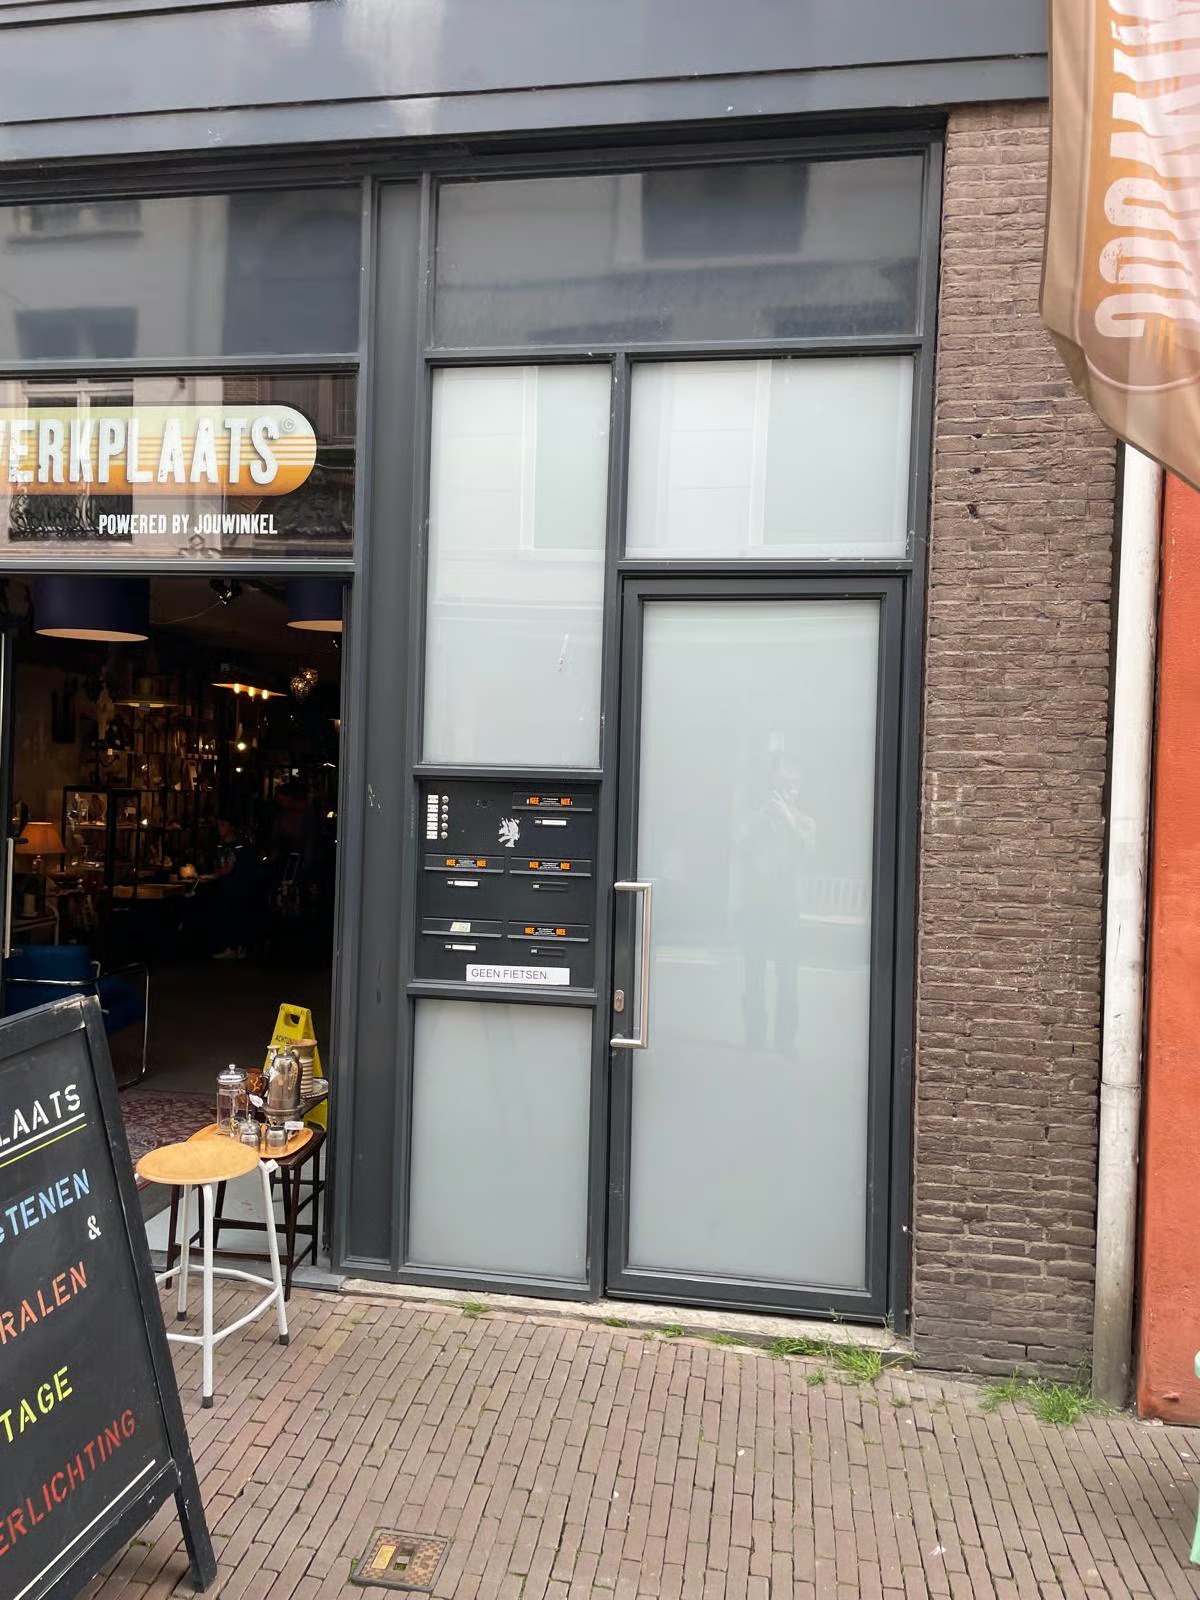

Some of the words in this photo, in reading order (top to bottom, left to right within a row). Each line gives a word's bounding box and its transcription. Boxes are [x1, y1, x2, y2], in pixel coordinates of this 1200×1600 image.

[0, 418, 280, 485] ERKPLAATS
[98, 514, 167, 534] POWERED
[171, 514, 190, 534] BY
[193, 514, 278, 535] JOUWINKEL
[471, 968, 501, 979] GEEN
[503, 969, 547, 980] FIETSEN
[87, 1215, 102, 1240] &
[0, 1260, 87, 1345] RALEN
[0, 1366, 73, 1443] TAGE
